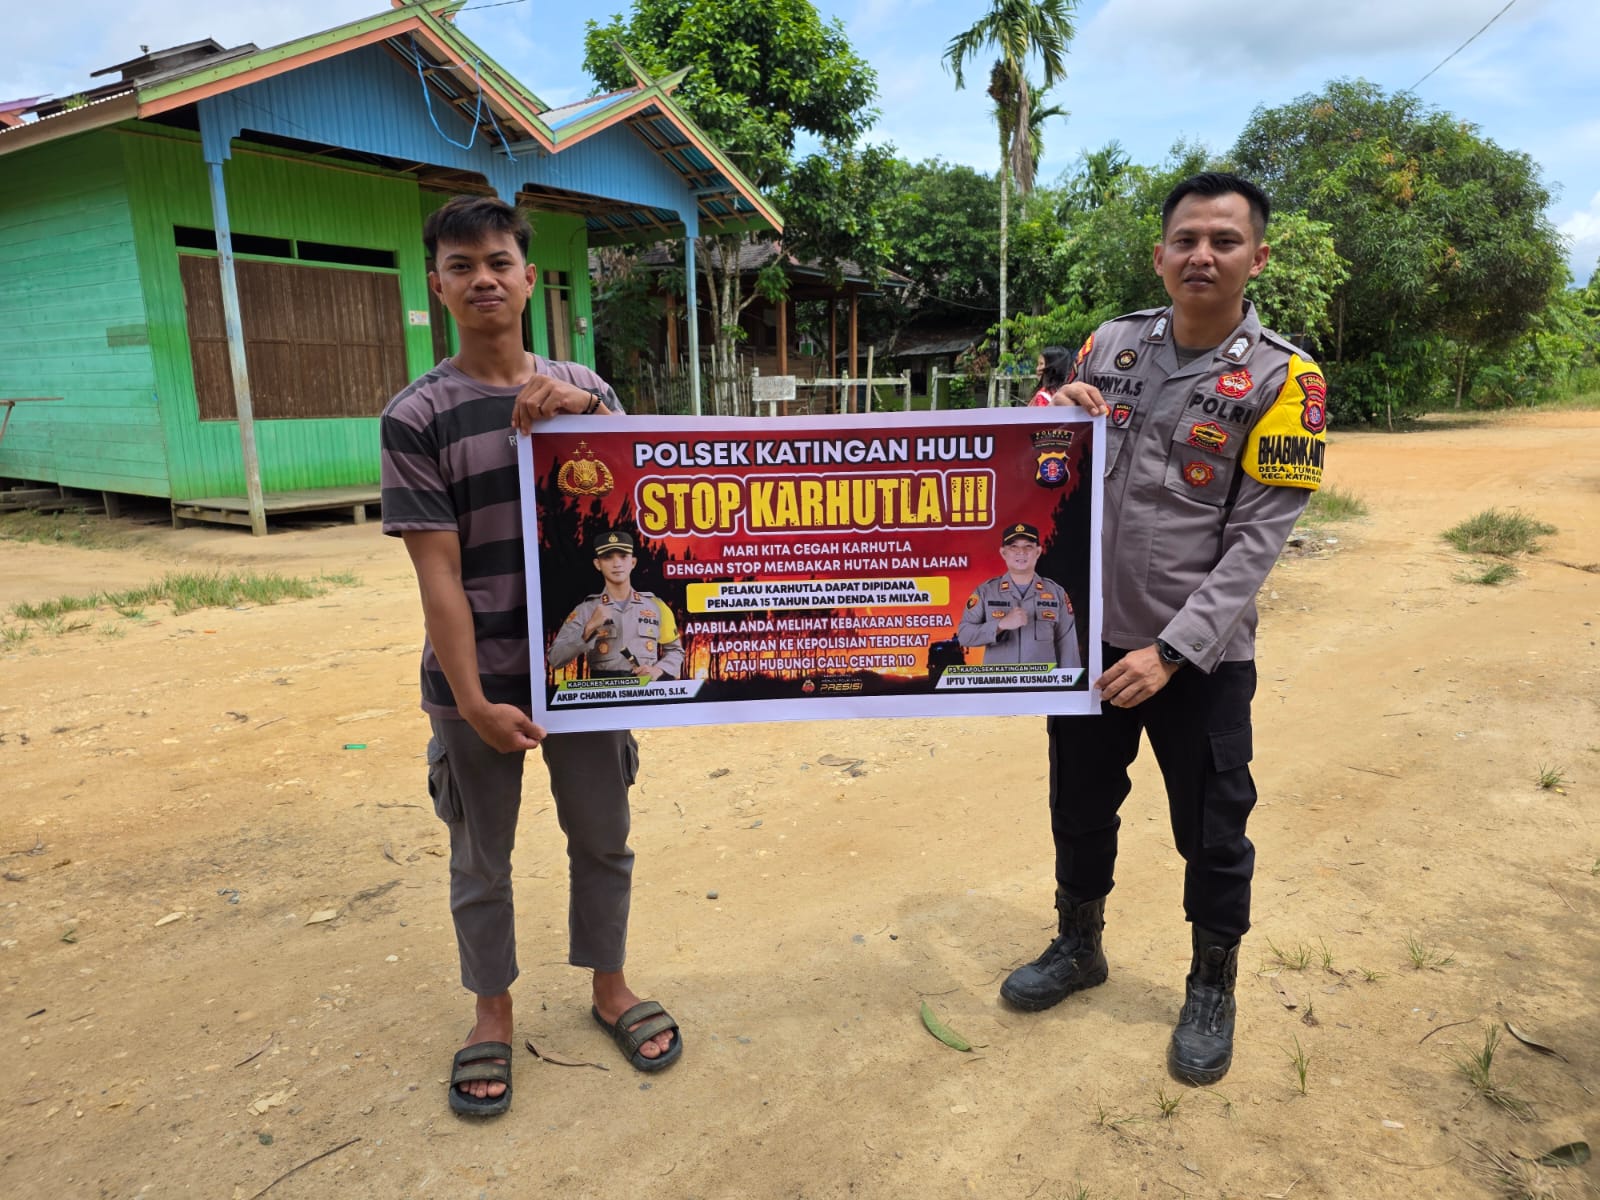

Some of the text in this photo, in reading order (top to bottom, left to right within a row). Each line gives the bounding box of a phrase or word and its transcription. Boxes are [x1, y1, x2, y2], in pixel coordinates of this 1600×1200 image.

[1188, 393, 1254, 424] POLRI
[635, 436, 994, 466] POLSEK KATINGAN HULU
[642, 475, 988, 531] STOP KARHUTLA !!!
[723, 541, 912, 557] MARI KITA CEGAH KARHUTLA
[666, 556, 968, 575] DENGAN STOP MEMBAKAR HUTAN DAN LAHAN
[721, 581, 915, 595] PELAKU KARHUTLA DAPAT DIPIDANA
[707, 593, 929, 609] PENJARA 15 TAHUN DAN DENDA 15 MILYAR
[685, 615, 952, 634] APABILA ANDA MELIHAT KEBAKARAN SEGERA
[710, 635, 929, 653] LAPORKAN KE KEPOLISIAN TERDEKAT
[725, 654, 915, 672] ATAU HUBUNGI CALL CENTER 110
[605, 679, 639, 687] KATINGAN
[820, 682, 863, 690] PRESISI
[946, 674, 1073, 686] IPTU YUBAMBANG KUSNADY, SH
[557, 687, 688, 701] AKBP CHANDRA ISMAWANTO, S.I.K.
